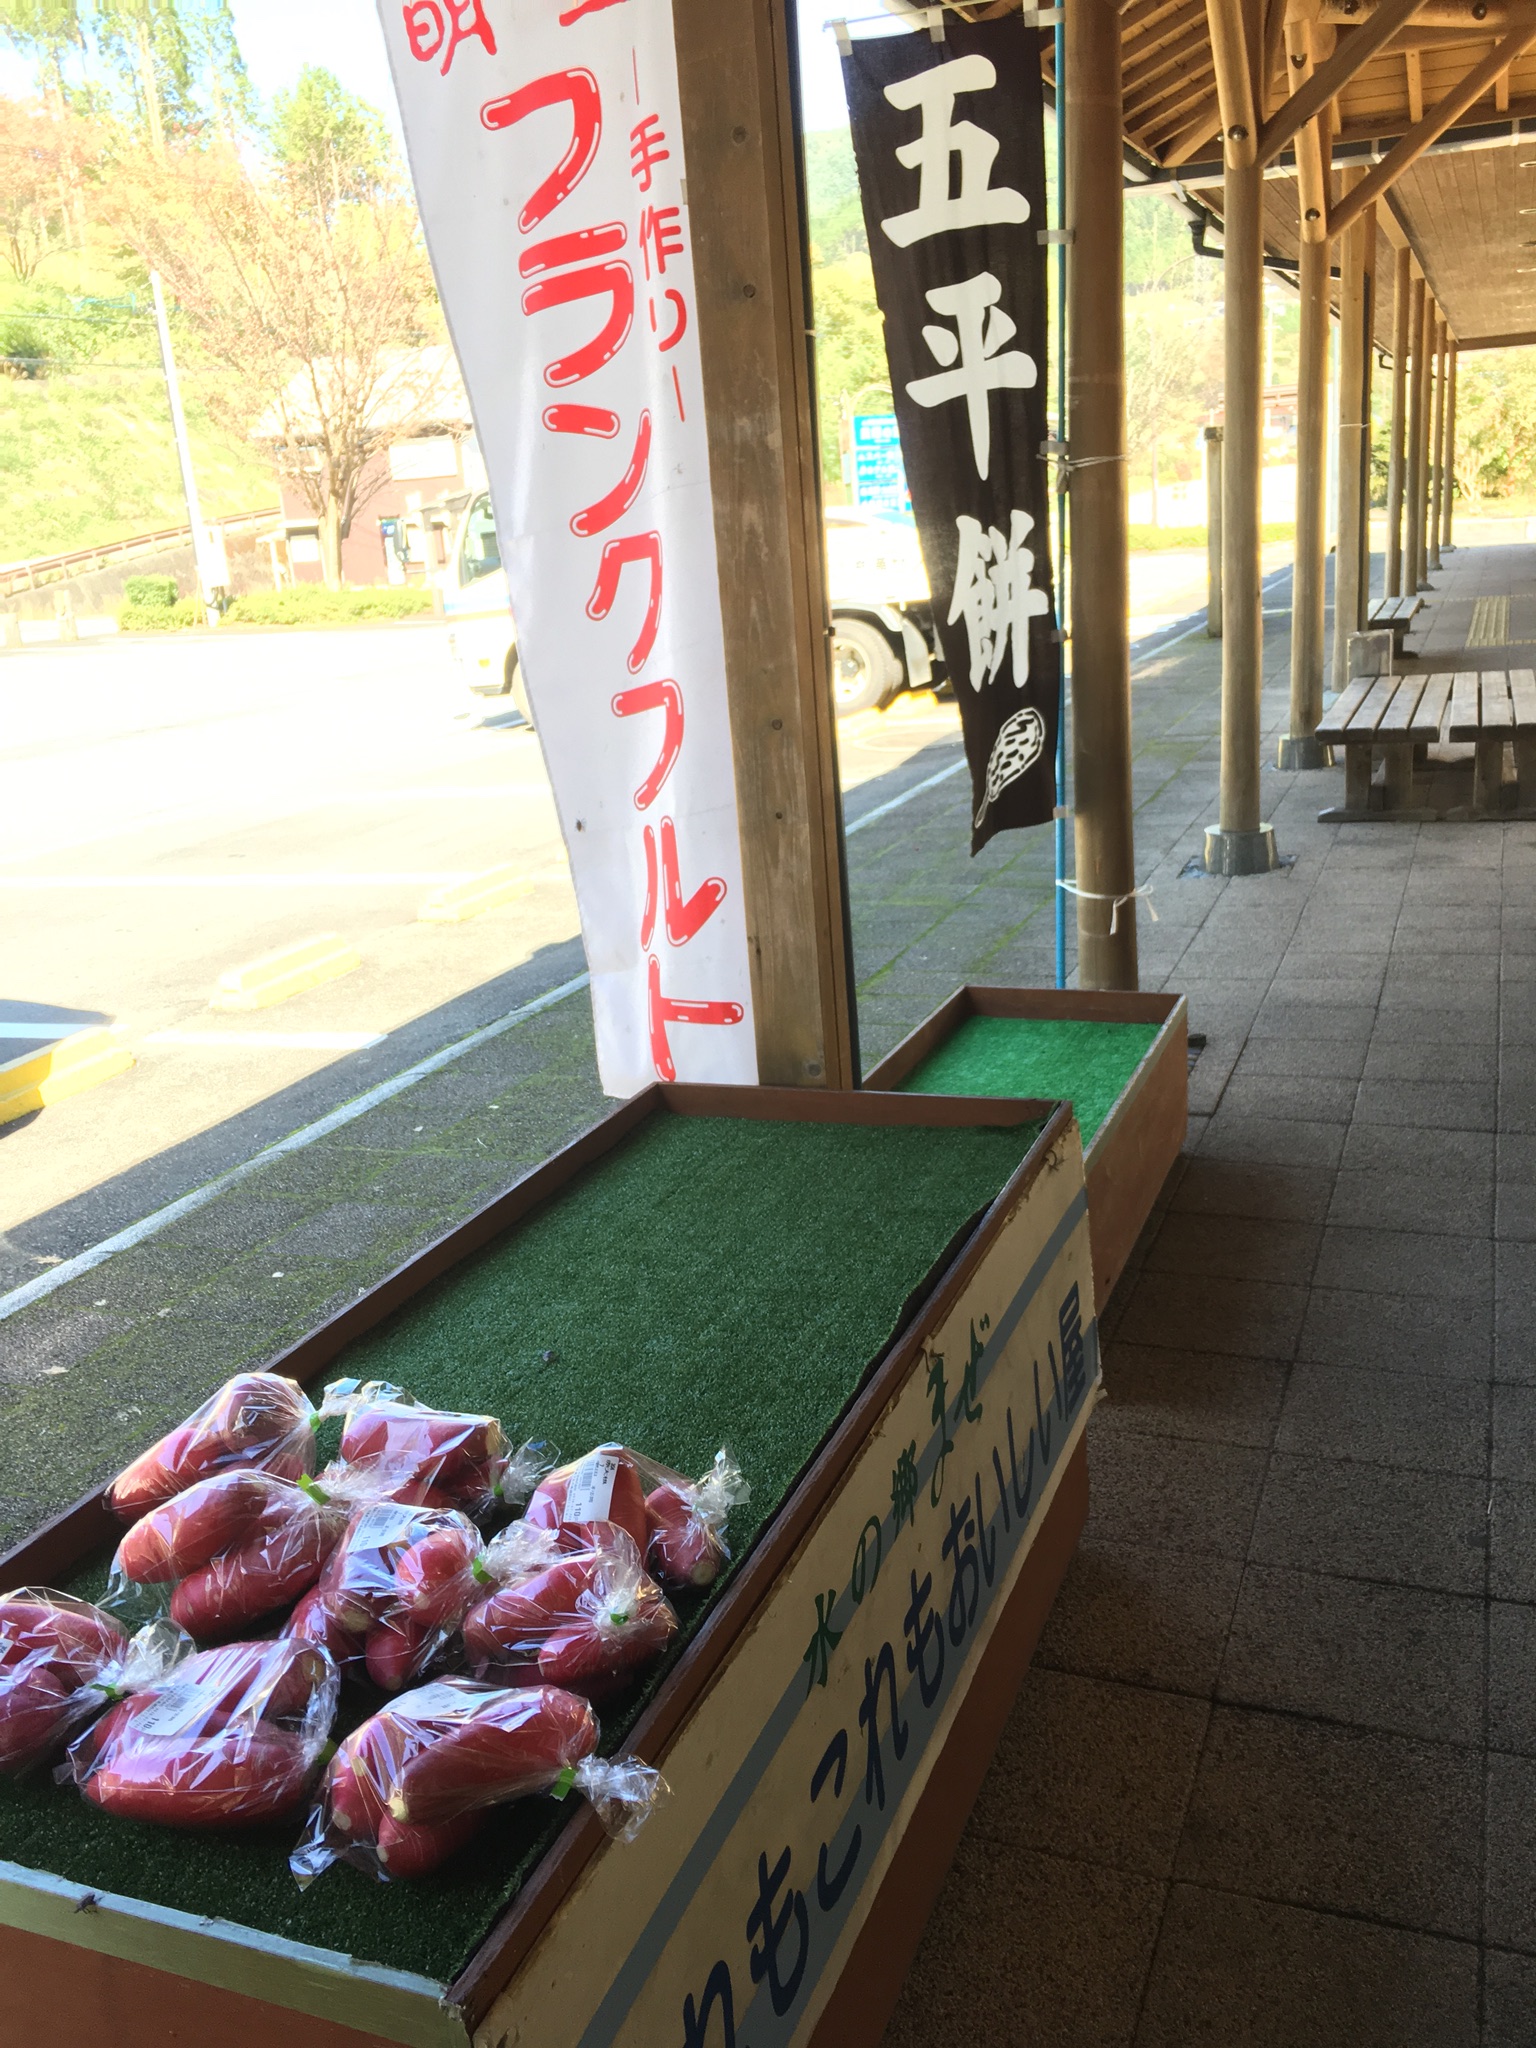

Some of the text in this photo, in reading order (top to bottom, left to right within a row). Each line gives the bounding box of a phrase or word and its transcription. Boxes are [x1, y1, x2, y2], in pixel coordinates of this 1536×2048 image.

[480, 65, 744, 1082] フランクフルト
[881, 54, 1049, 692] 五平餅
